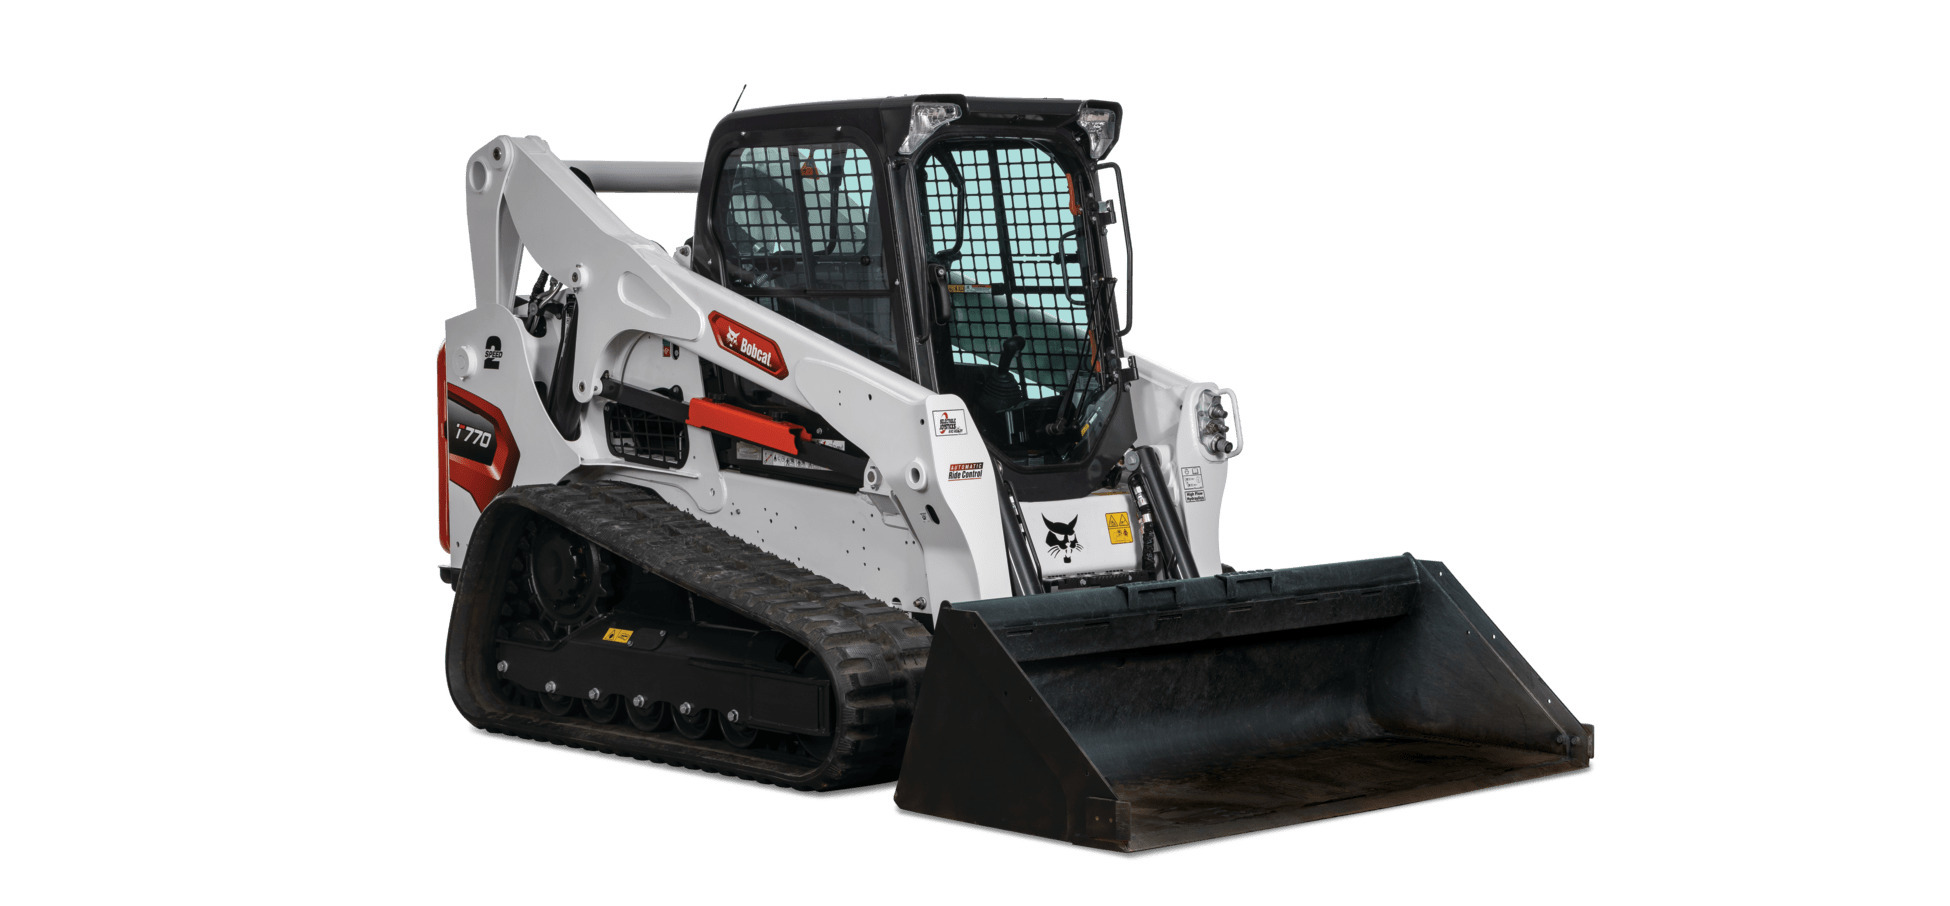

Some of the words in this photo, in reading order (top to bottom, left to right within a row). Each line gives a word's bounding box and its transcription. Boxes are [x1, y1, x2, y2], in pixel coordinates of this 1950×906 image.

[484, 335, 502, 370] 2
[484, 350, 503, 358] SPEED
[740, 337, 772, 367] Bobcat
[456, 423, 492, 448] T770
[948, 471, 961, 480] Ride
[962, 469, 982, 478] Control
